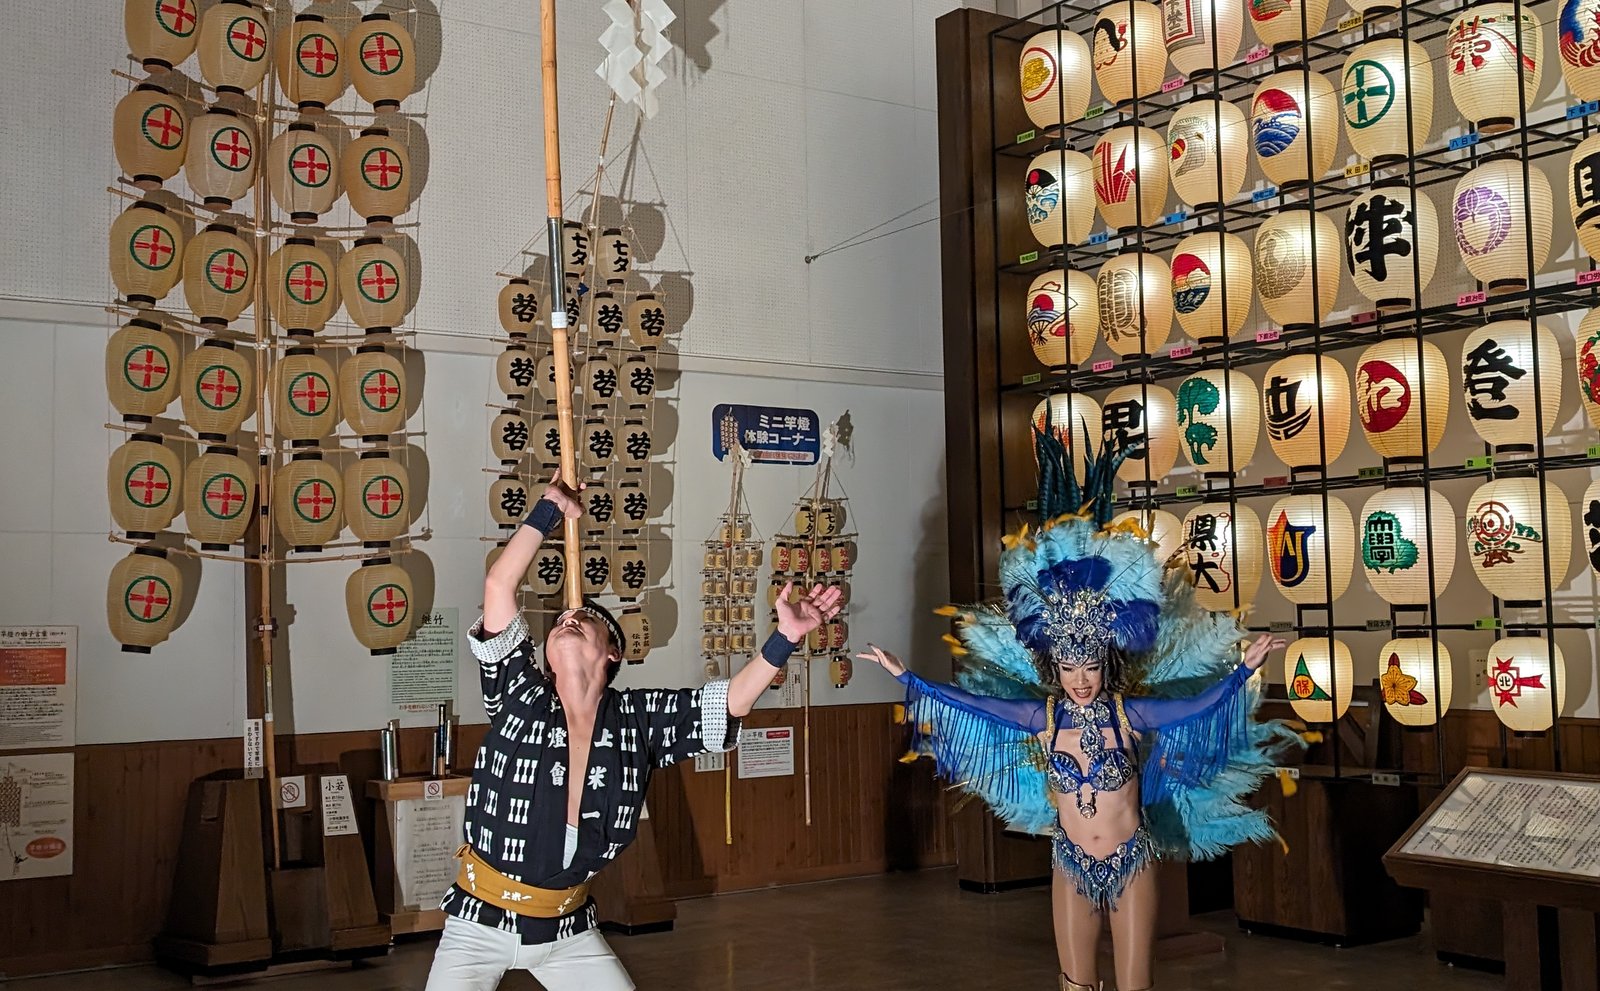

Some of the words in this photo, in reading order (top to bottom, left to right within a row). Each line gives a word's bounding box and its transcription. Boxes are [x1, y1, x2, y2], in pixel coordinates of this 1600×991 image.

[1451, 134, 1477, 148] 八日町
[1346, 163, 1369, 175] 秋田市
[570, 232, 588, 266] 七夕
[612, 240, 629, 273] 七夕
[511, 292, 538, 323] 若
[1459, 293, 1485, 305] 上鍛冶町
[597, 303, 624, 334] 若
[640, 307, 665, 337] 若
[509, 357, 535, 387] 若
[592, 368, 617, 398] 若
[630, 366, 655, 396] 若
[502, 420, 529, 451] 若
[744, 429, 816, 446] 体験コーナー
[759, 414, 811, 431] ミニ竿燈
[589, 429, 614, 459] 若
[626, 430, 651, 460] 若
[500, 486, 527, 517] 若
[588, 492, 614, 522] 若
[623, 491, 648, 521] 若
[825, 513, 836, 535] 七夕
[538, 555, 564, 585] 若
[584, 556, 609, 586] 若
[622, 559, 646, 589] 若
[1499, 675, 1511, 689] 北
[325, 781, 345, 792] 小若
